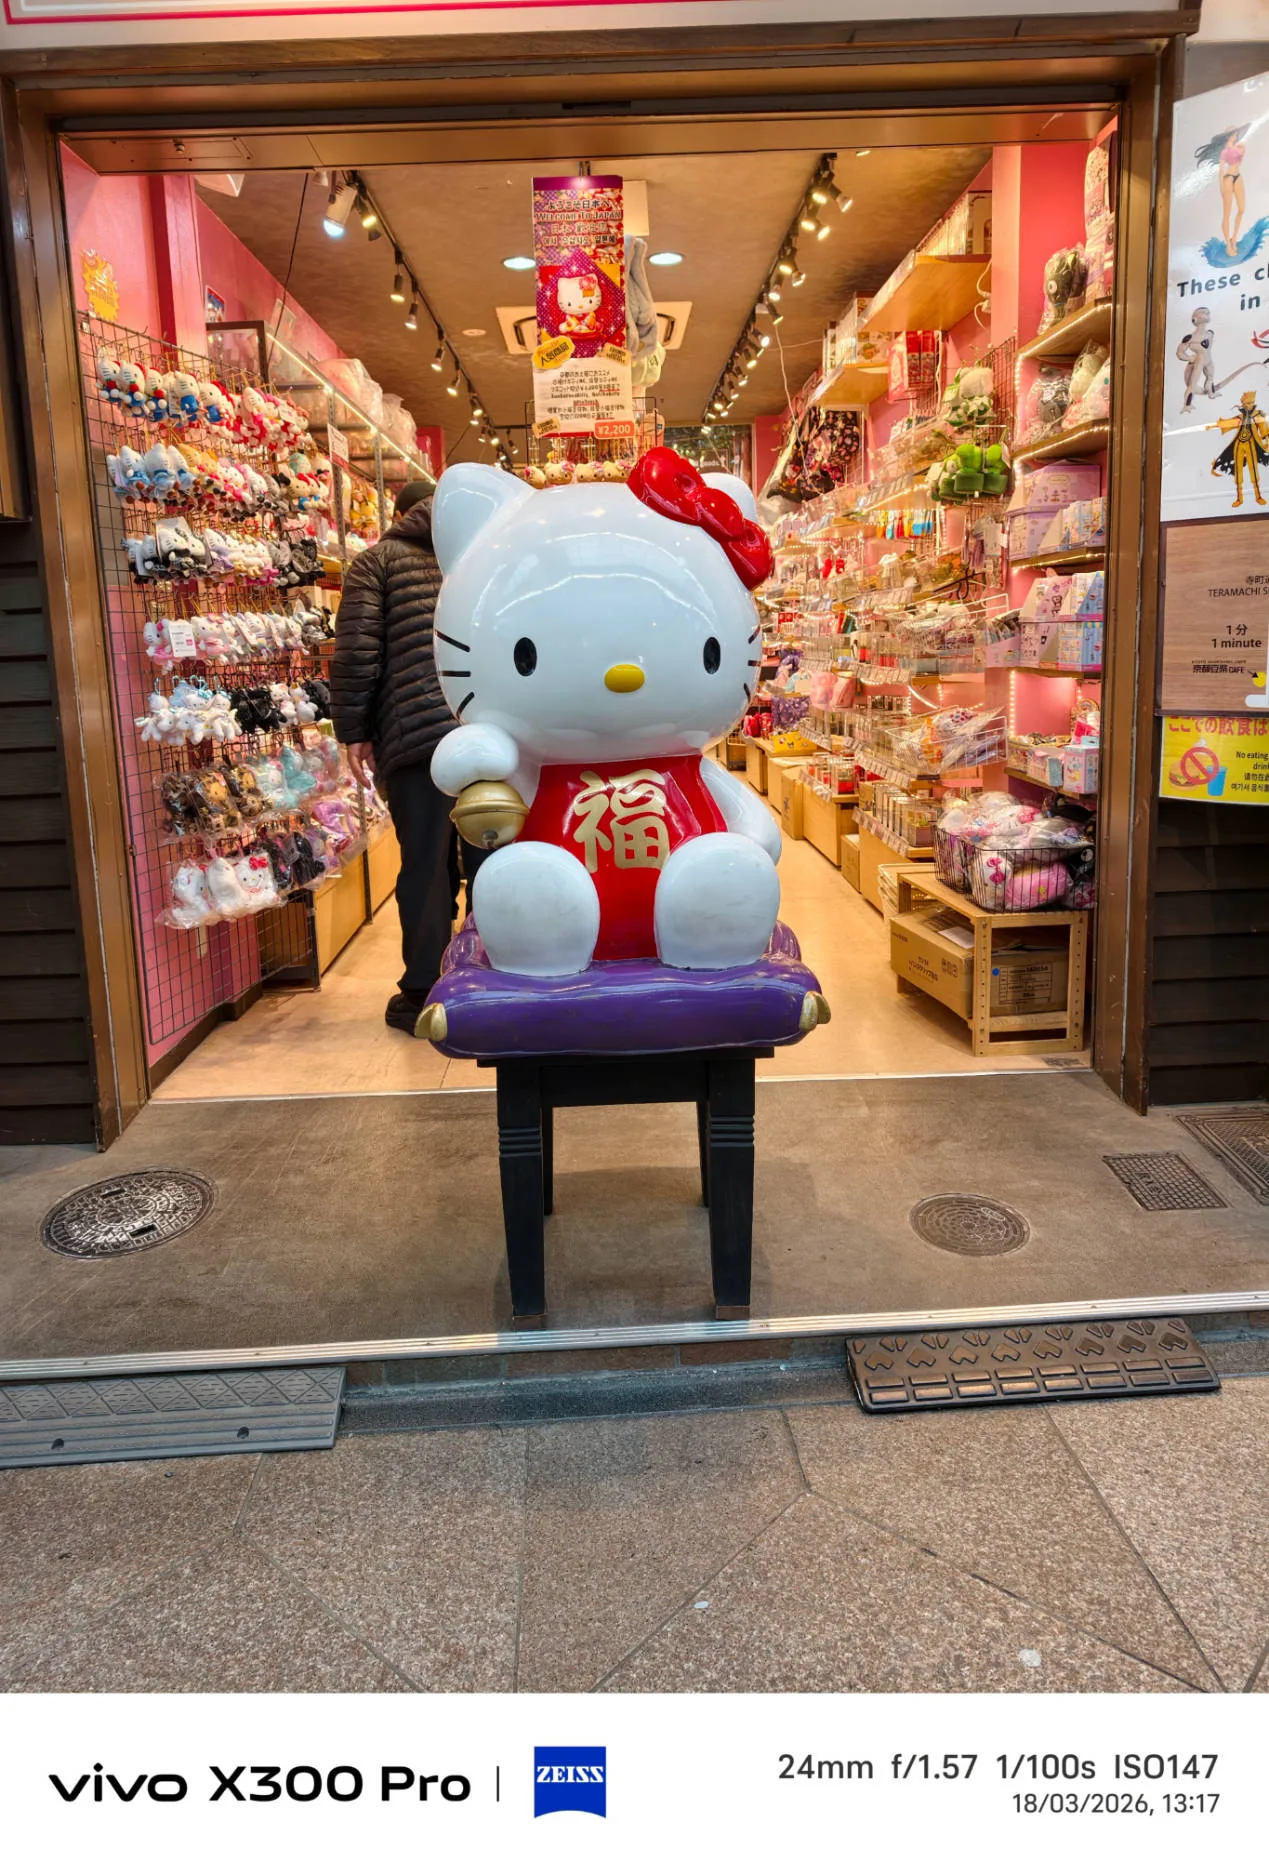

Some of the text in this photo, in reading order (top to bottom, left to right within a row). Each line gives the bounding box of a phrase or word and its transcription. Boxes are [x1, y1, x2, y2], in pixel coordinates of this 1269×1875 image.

[548, 200, 610, 210] ようこそ日本へ
[536, 211, 578, 221] WELCOME
[593, 209, 622, 219] JAPAN
[1177, 263, 1269, 298] These c
[1240, 294, 1260, 311] in
[1208, 587, 1260, 597] TERAMACHI
[1212, 638, 1262, 648] 1 minute
[1236, 751, 1268, 760] No eating
[573, 768, 670, 874] 福
